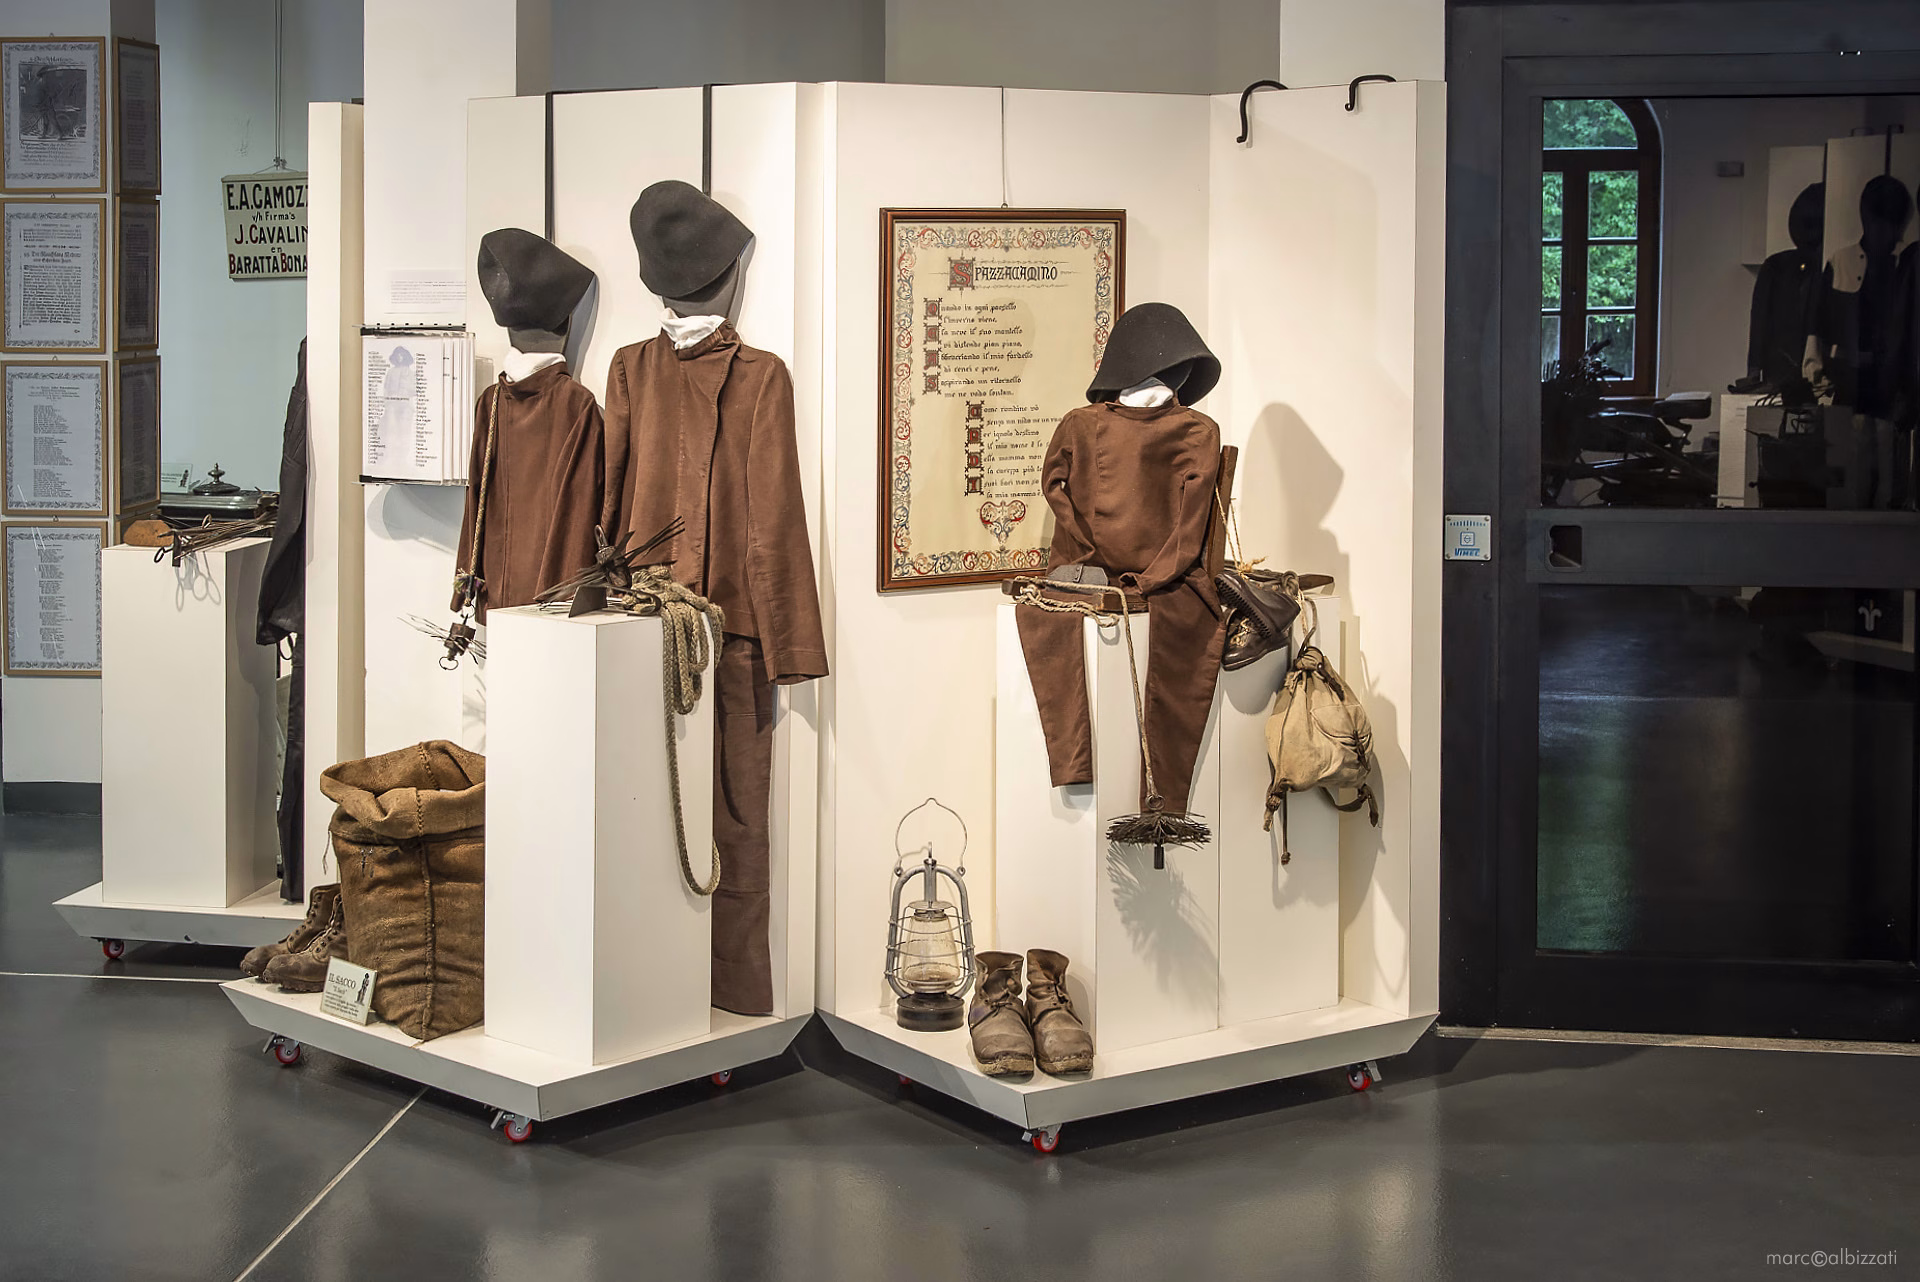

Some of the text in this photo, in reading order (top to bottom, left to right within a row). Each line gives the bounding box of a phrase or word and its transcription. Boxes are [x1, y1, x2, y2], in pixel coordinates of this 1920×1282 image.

[227, 183, 308, 210] E.A.CAMOZ
[265, 211, 295, 221] Firma's
[228, 253, 280, 274] BARATTA
